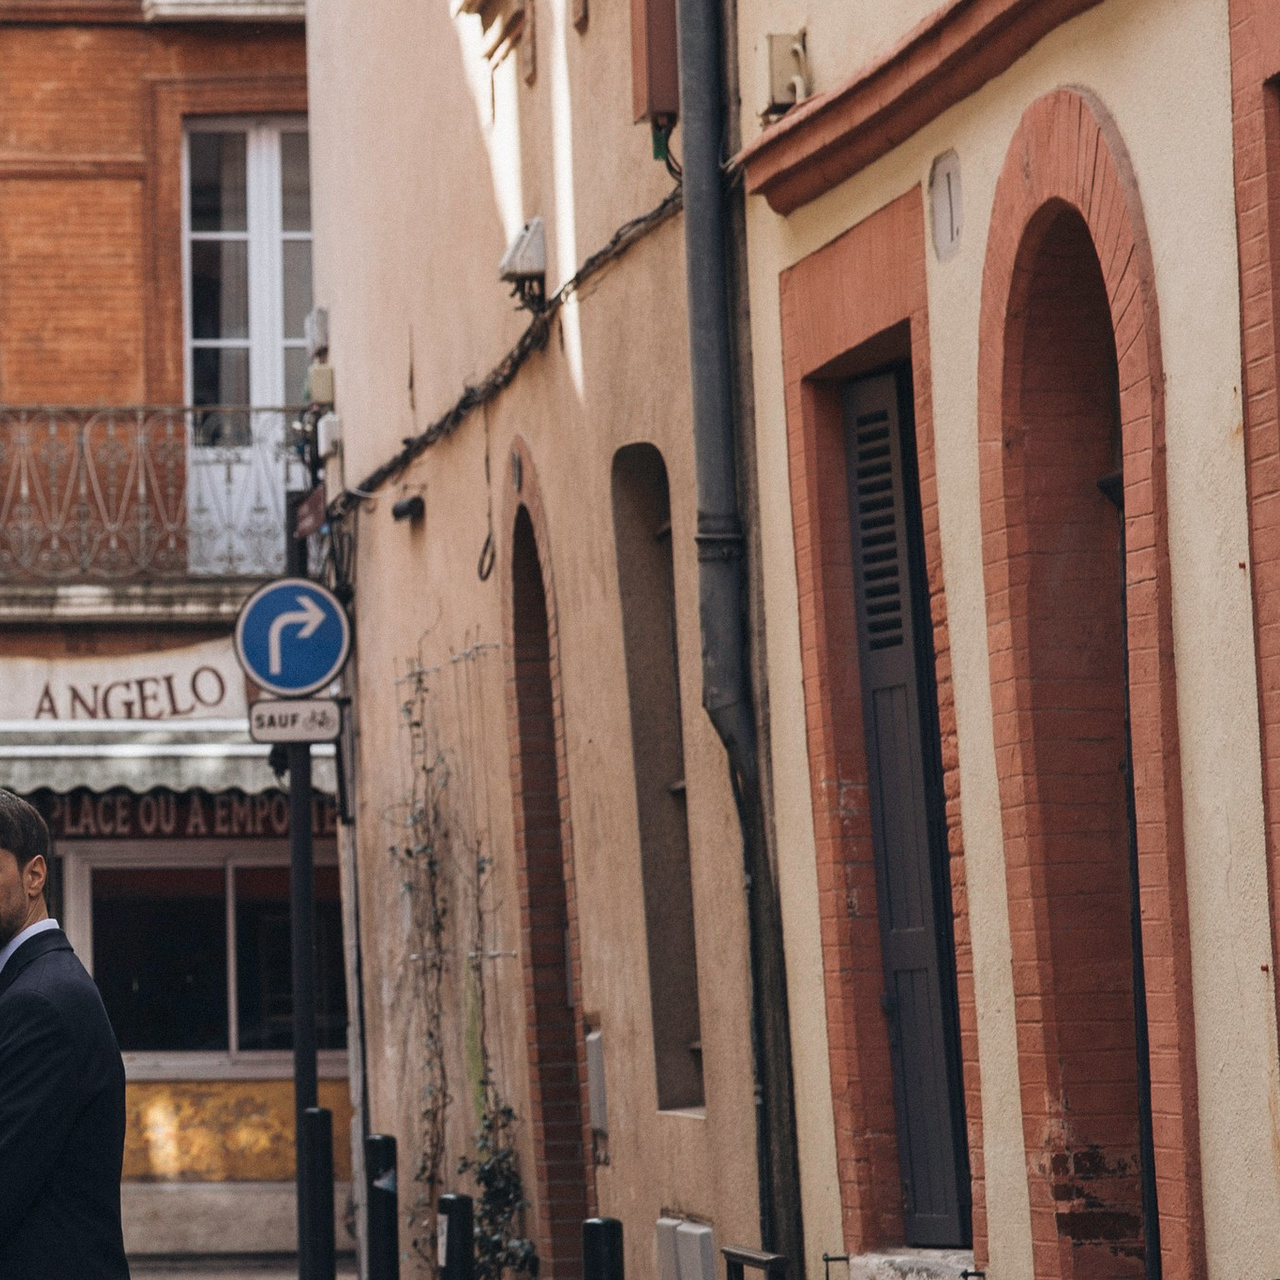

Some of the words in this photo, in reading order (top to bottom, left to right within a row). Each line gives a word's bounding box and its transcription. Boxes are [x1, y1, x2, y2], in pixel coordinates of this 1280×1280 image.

[34, 665, 227, 719] ANGELO
[255, 712, 299, 729] SAUF
[138, 793, 176, 836] OU
